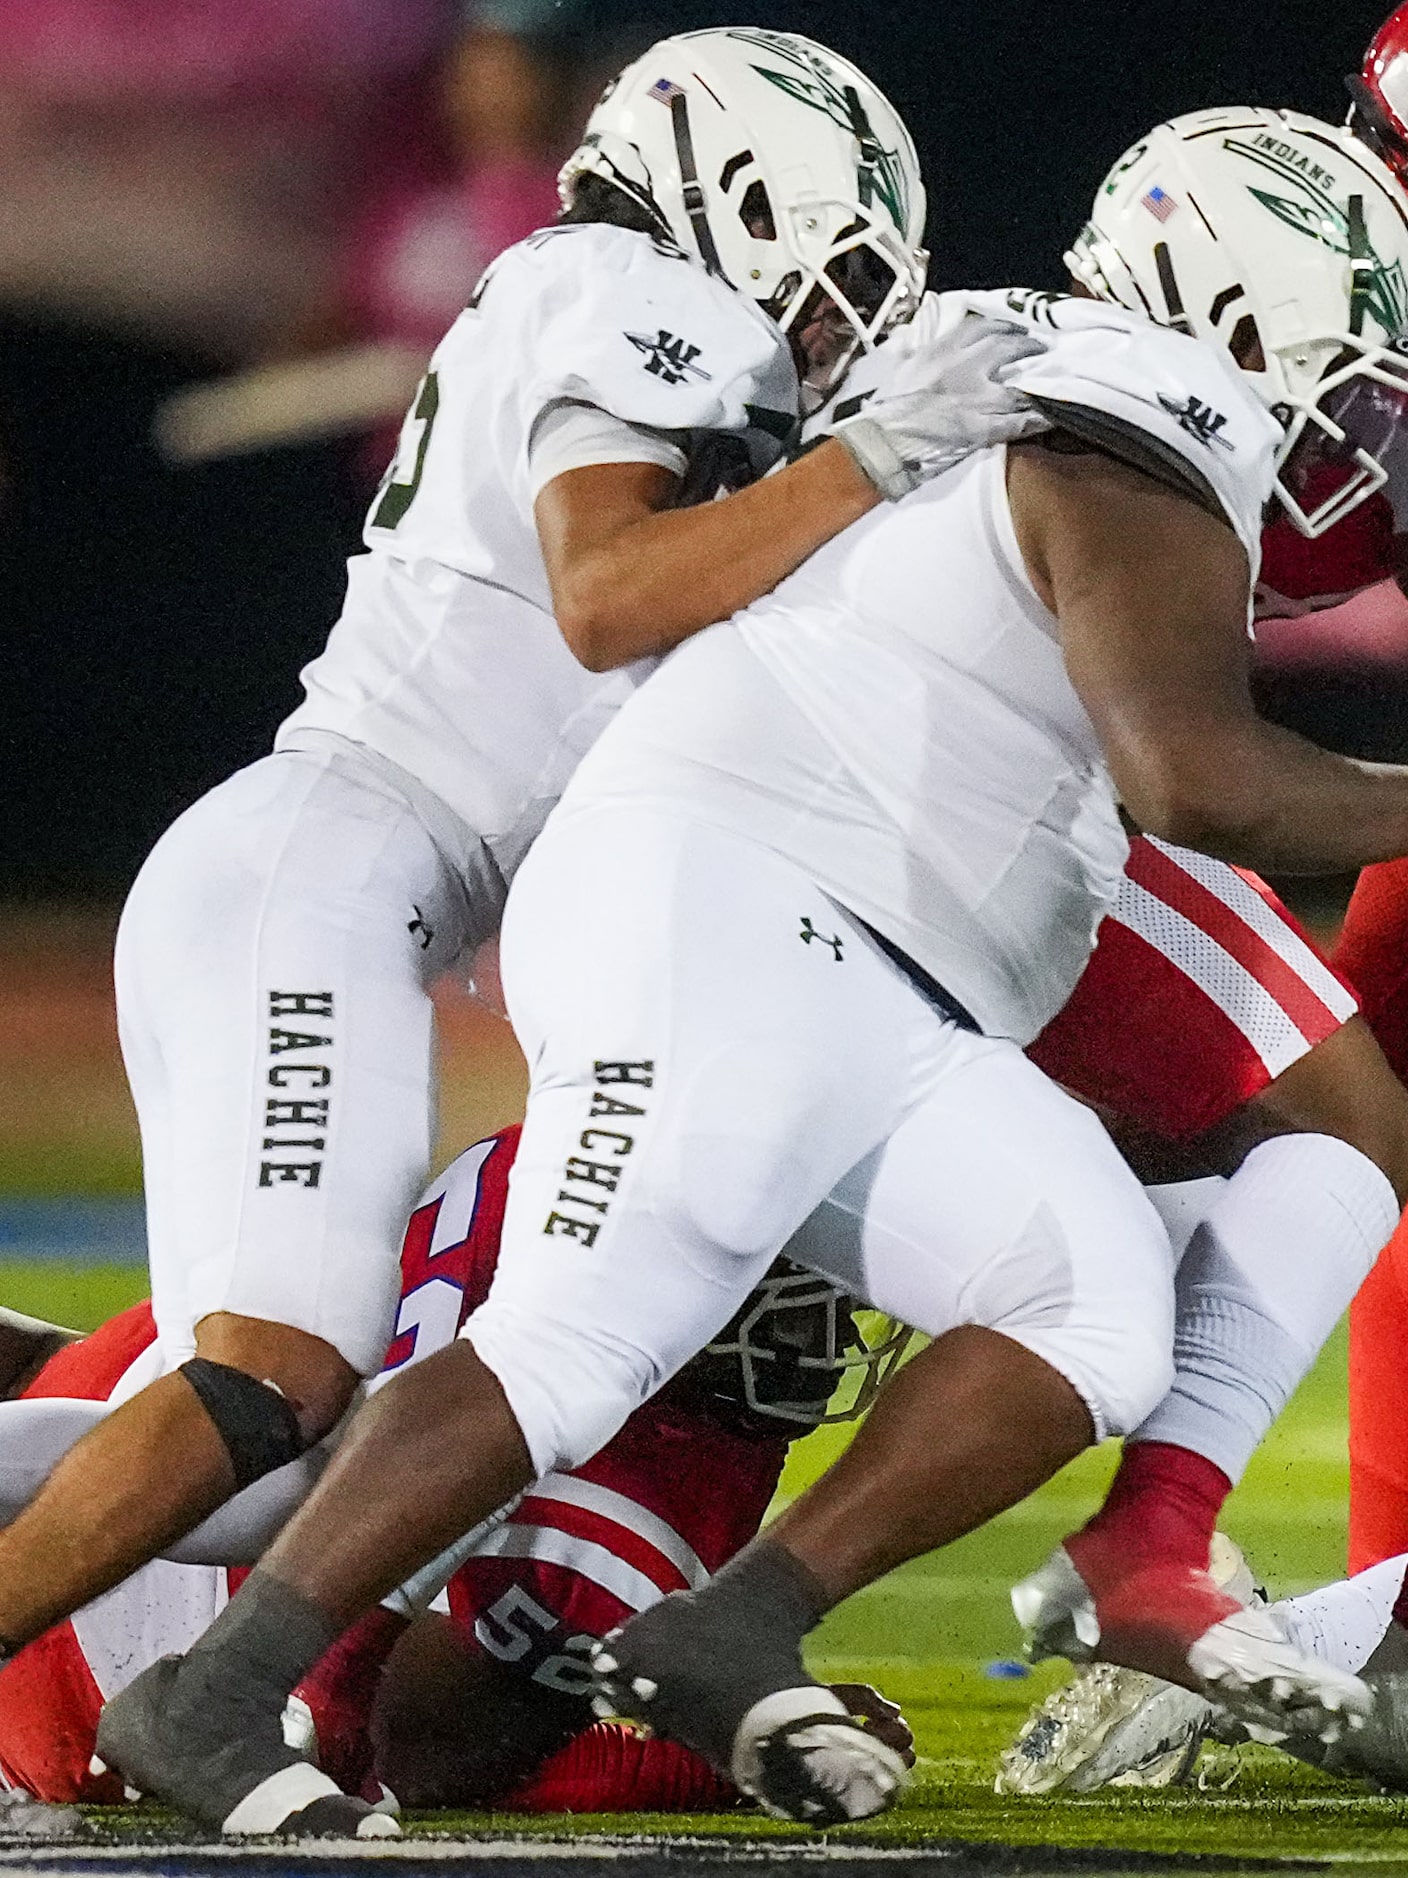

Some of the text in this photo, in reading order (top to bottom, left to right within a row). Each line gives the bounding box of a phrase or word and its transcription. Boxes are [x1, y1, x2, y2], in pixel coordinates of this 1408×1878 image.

[1253, 133, 1336, 191] INDIANS
[259, 991, 333, 1187] HACHIE
[544, 1060, 654, 1248] HACHIE
